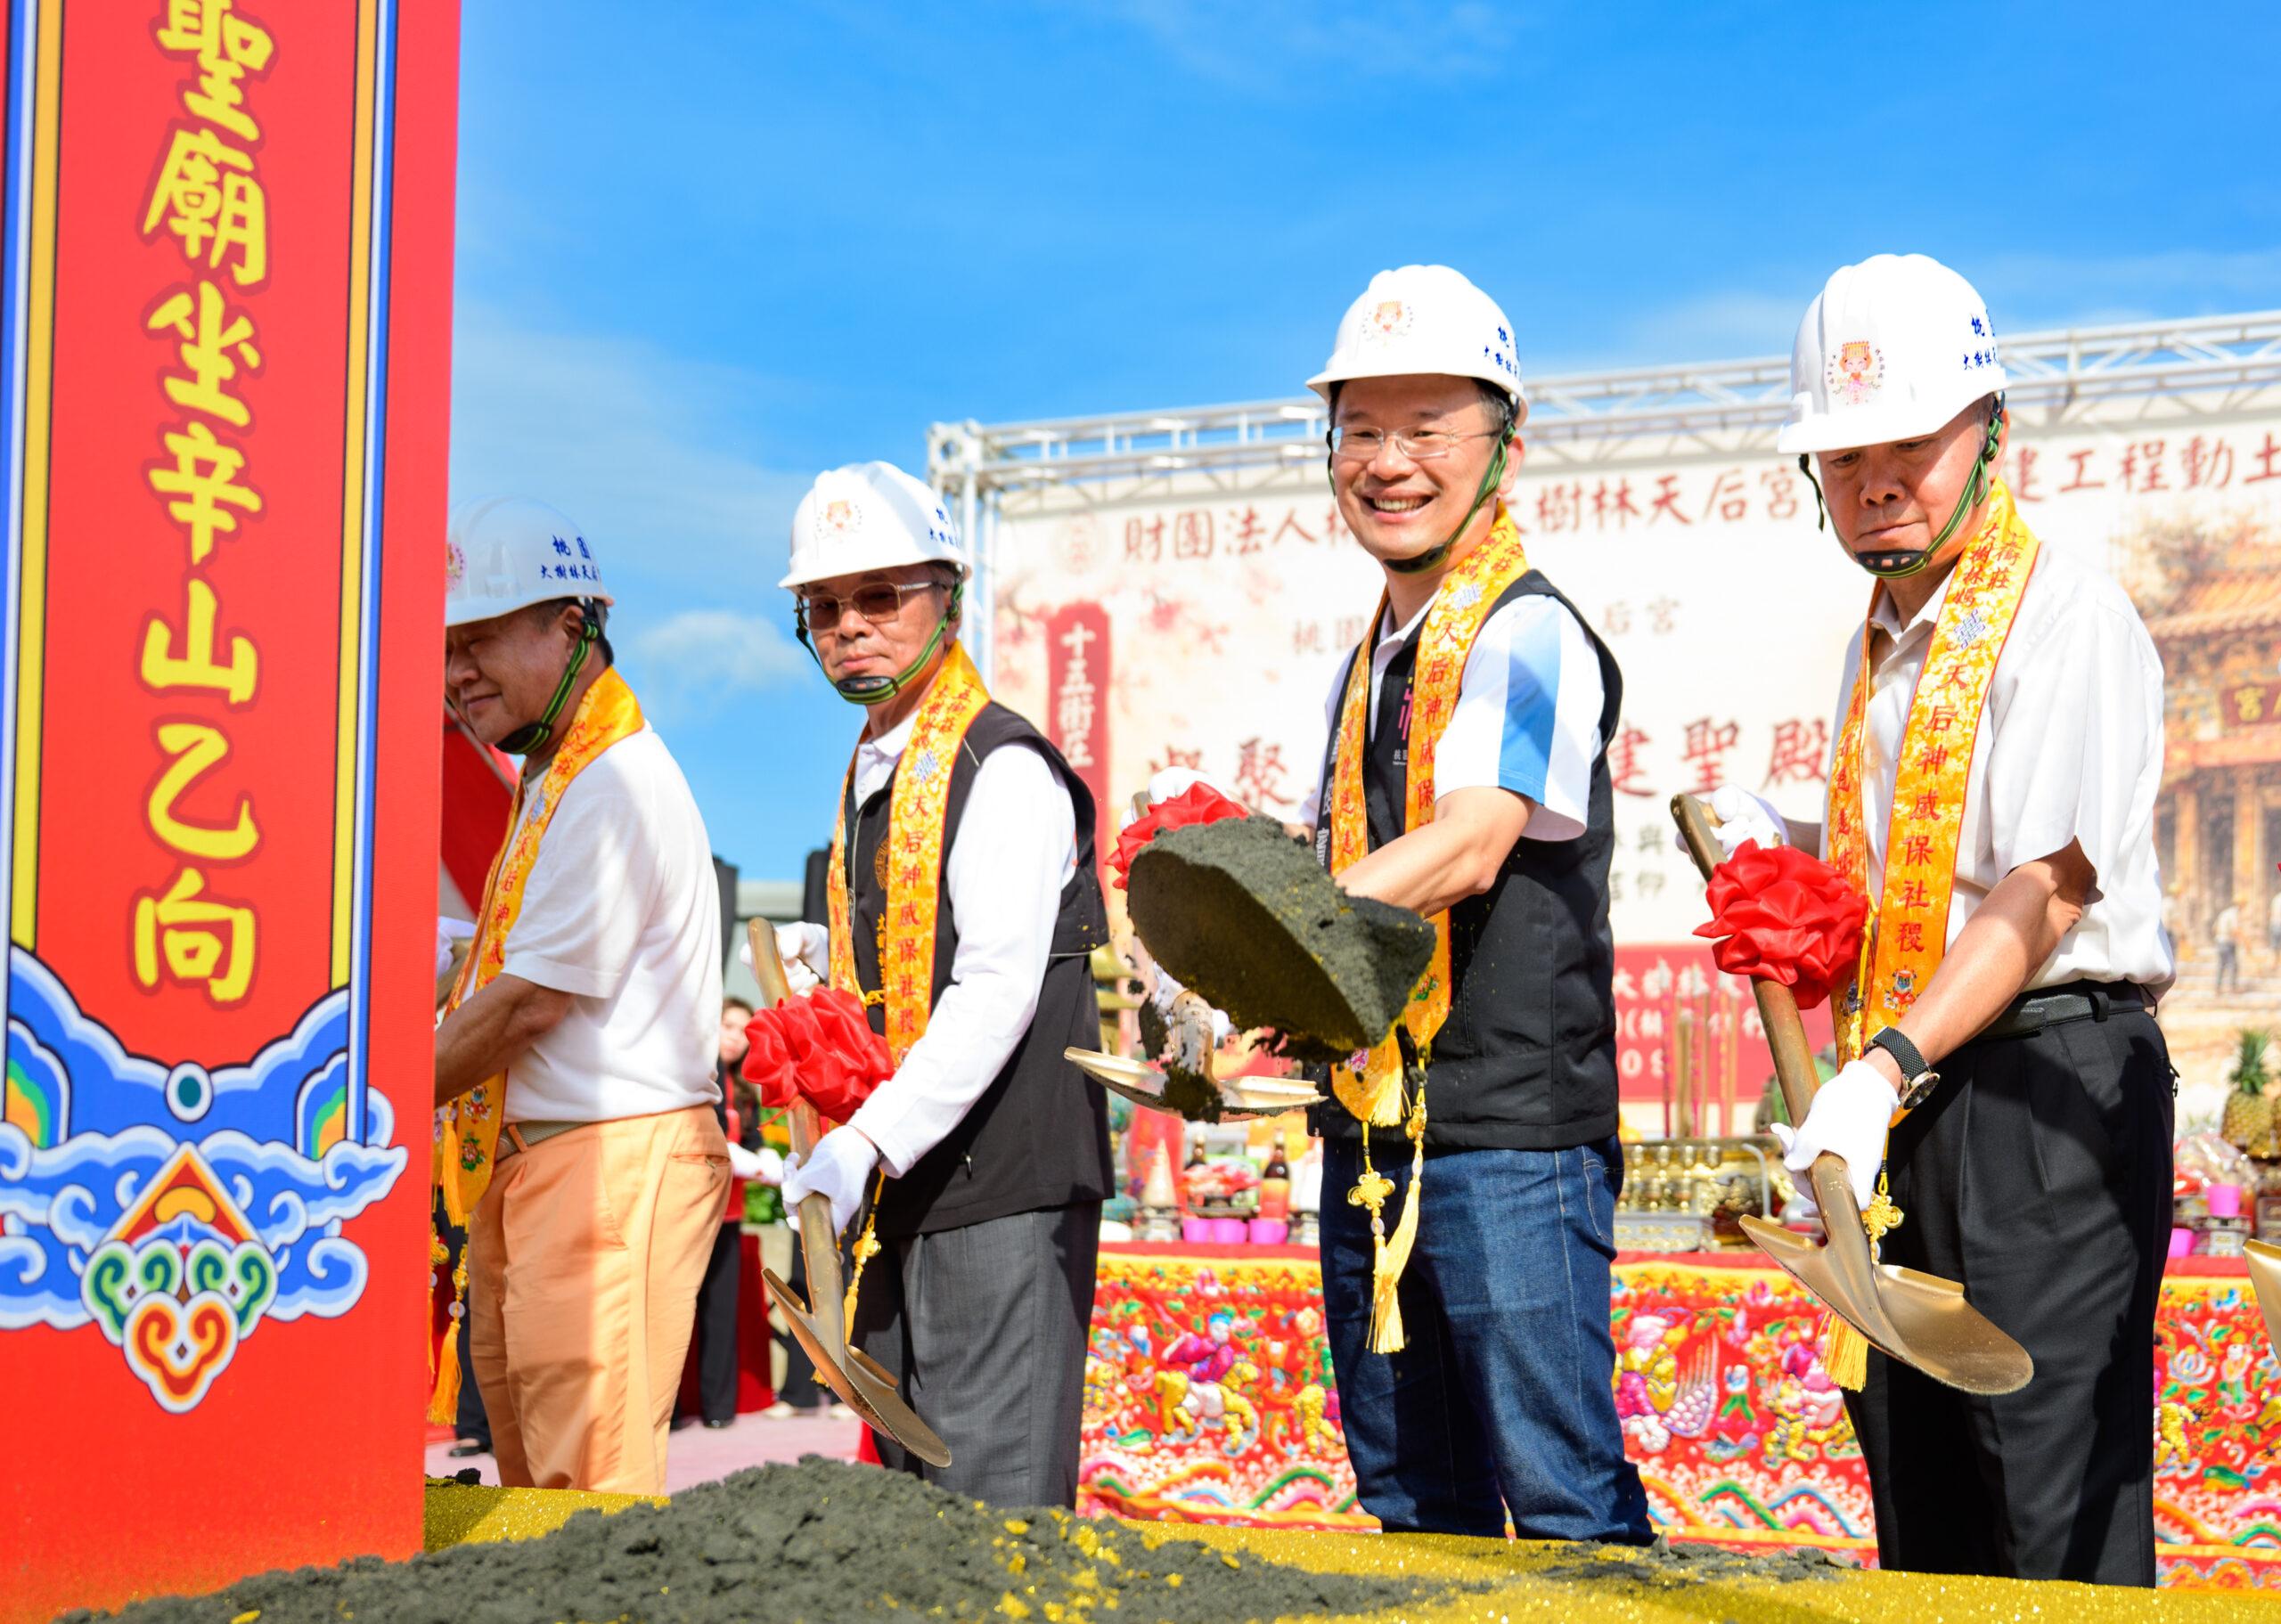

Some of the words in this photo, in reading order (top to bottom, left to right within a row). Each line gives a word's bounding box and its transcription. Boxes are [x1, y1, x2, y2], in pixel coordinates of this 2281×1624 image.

[1414, 620, 1459, 827] 天后神威保
